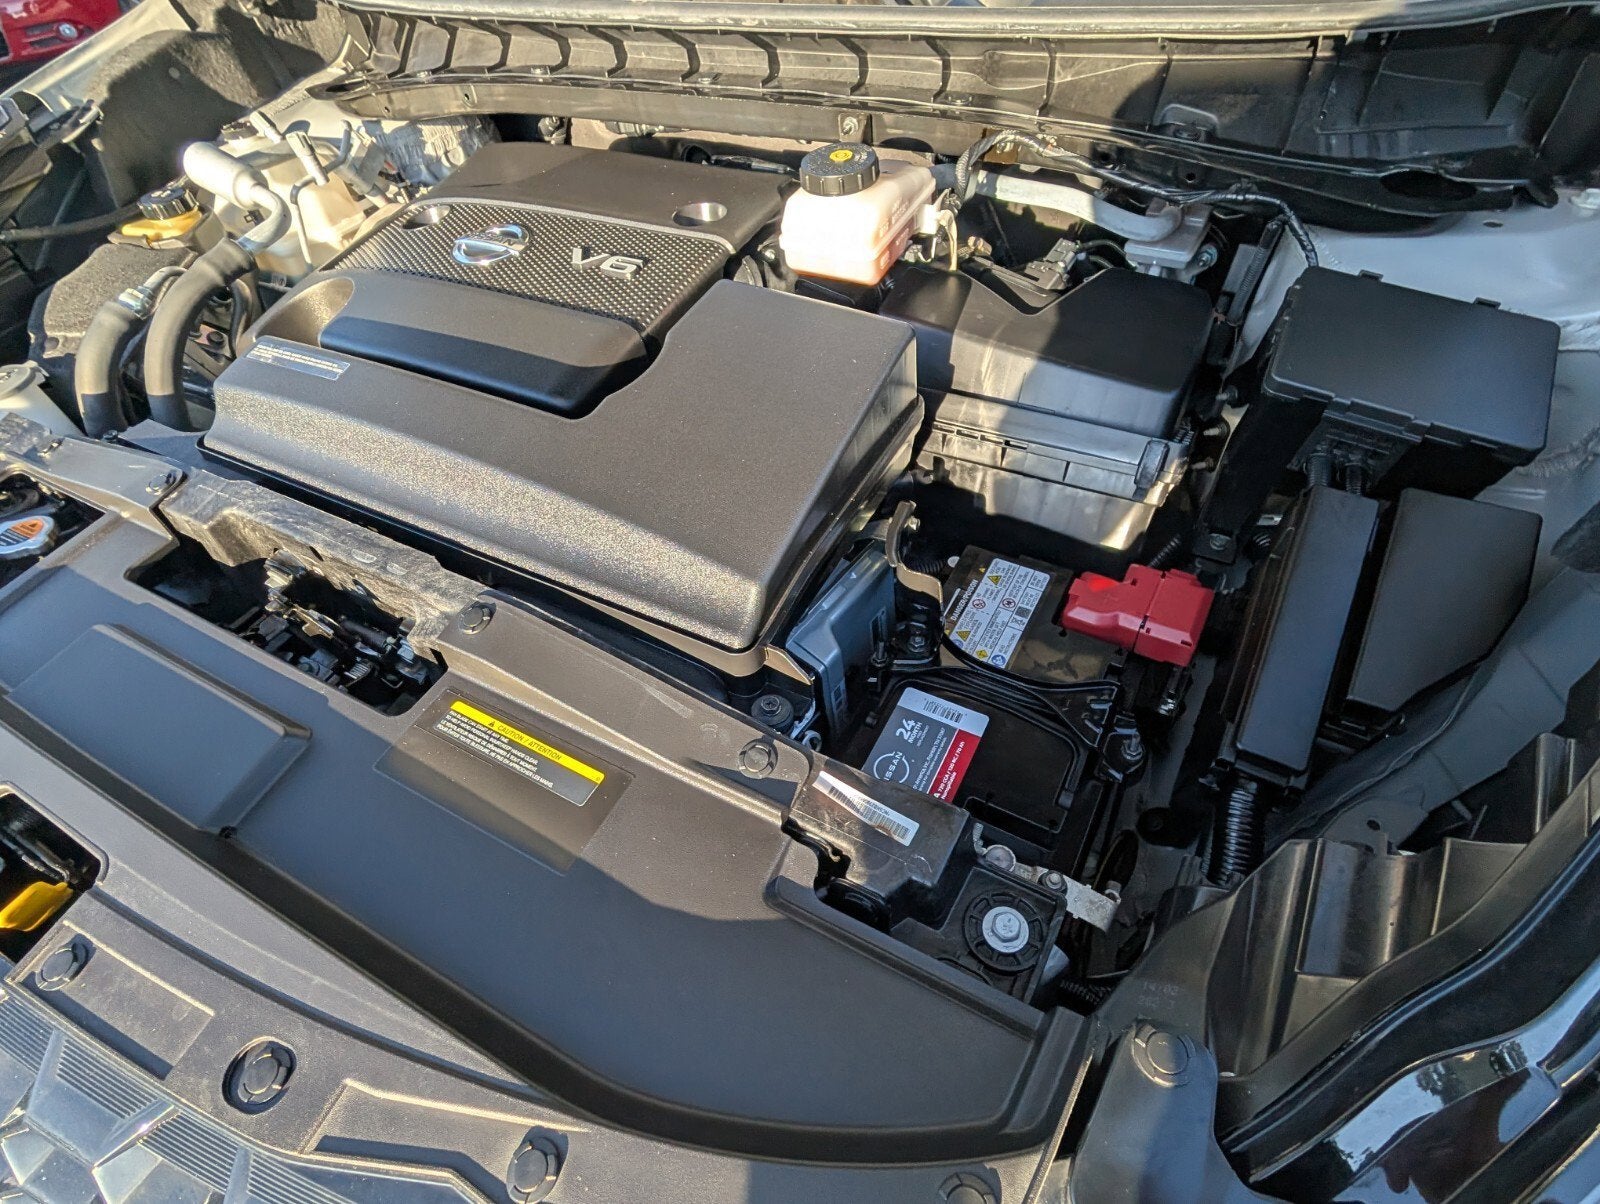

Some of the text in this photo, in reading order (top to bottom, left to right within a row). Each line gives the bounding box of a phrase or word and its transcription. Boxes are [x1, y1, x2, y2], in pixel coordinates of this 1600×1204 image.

[571, 247, 644, 280] V6
[950, 578, 978, 621] DANGER/POISON
[496, 724, 524, 741] CAUTION
[527, 740, 562, 760] ATTENTION
[894, 716, 917, 740] 24
[907, 721, 923, 743] MONTH
[882, 750, 903, 781] ISSAN
[941, 773, 949, 784] CCA
